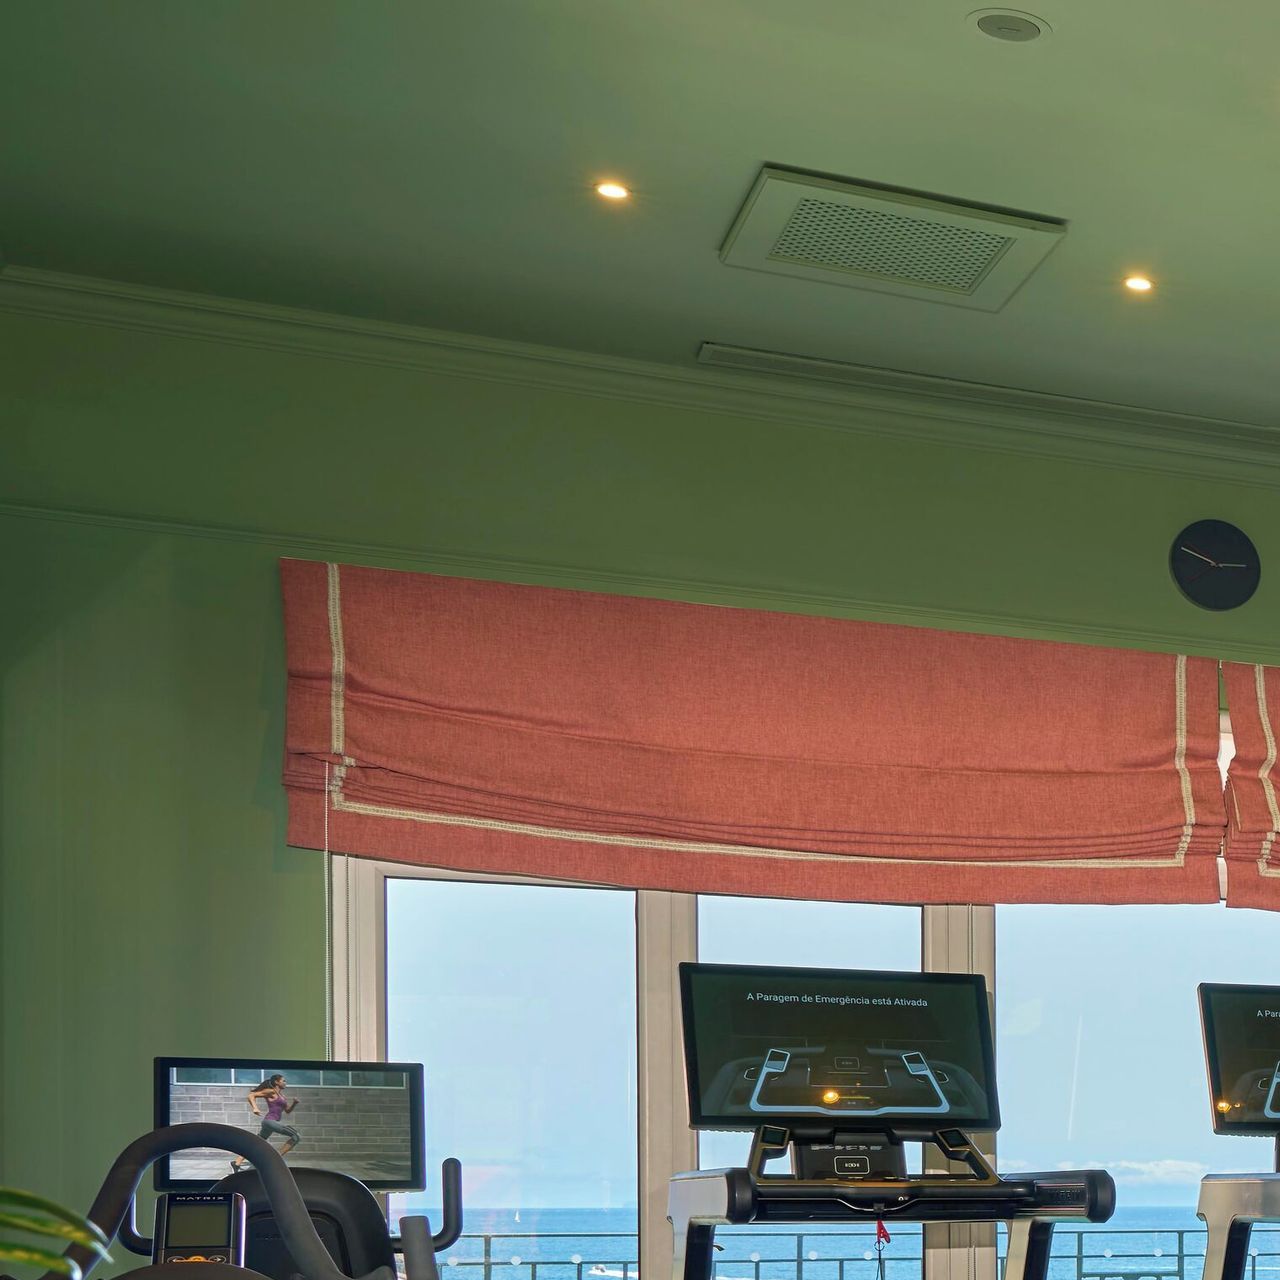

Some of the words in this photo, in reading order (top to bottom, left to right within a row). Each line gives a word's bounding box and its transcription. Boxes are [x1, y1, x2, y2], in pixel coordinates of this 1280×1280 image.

[746, 992, 755, 1000] A
[756, 993, 799, 1003] Paragem
[801, 994, 813, 1003] de
[815, 995, 870, 1006] Emergência
[872, 997, 892, 1005] está
[893, 998, 928, 1007] Ativada
